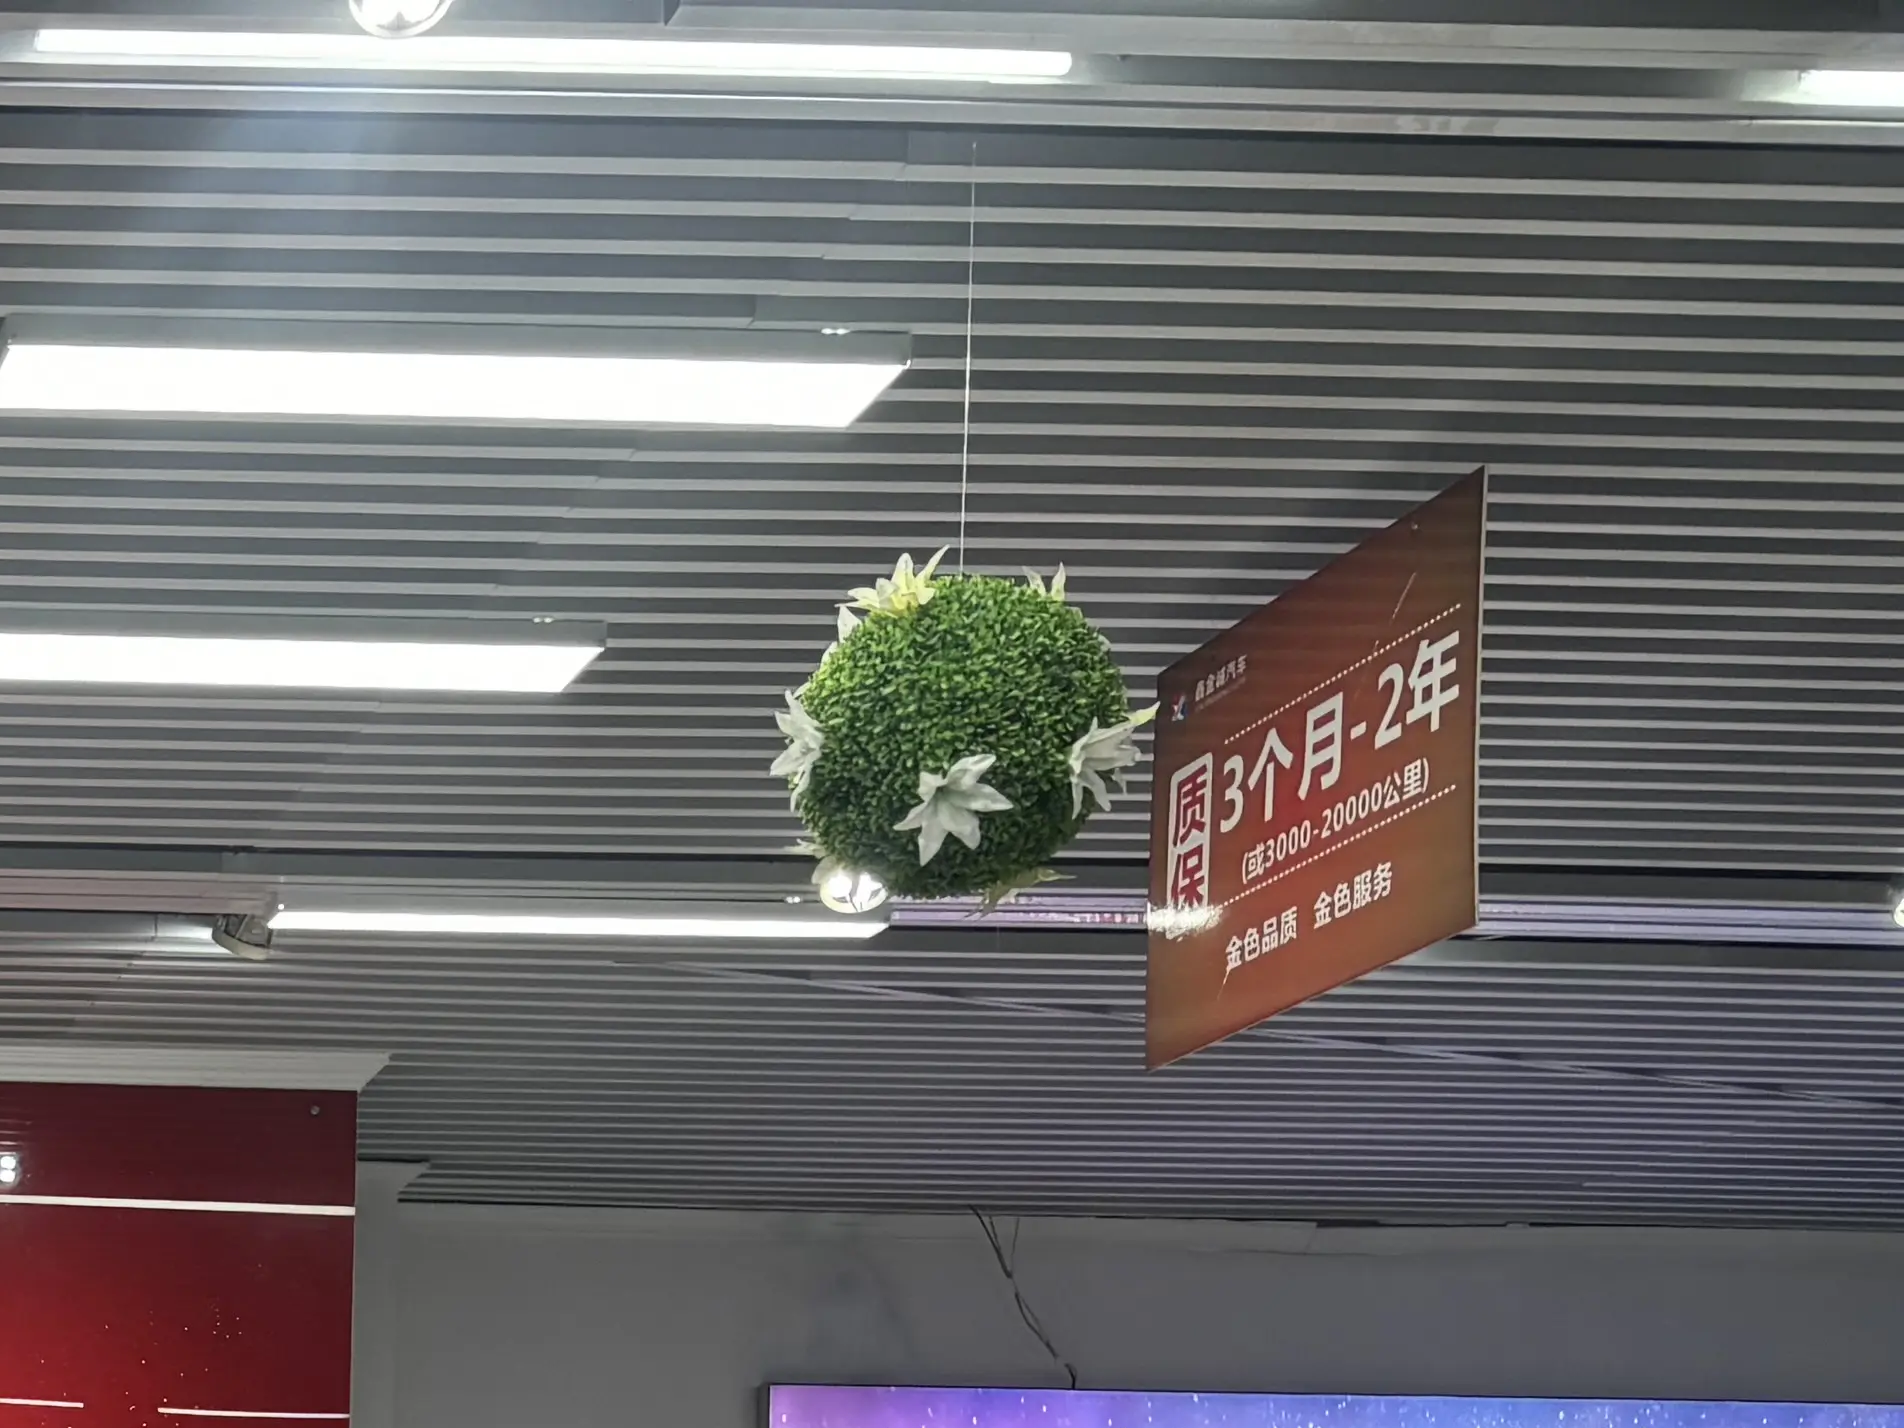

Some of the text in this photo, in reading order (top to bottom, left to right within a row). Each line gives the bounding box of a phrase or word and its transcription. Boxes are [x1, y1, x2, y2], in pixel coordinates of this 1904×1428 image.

[1220, 630, 1459, 834] 3个月-2年
[1242, 758, 1430, 885] (或3000-20000公里)
[1225, 862, 1393, 970] 金色品质 金色服务
